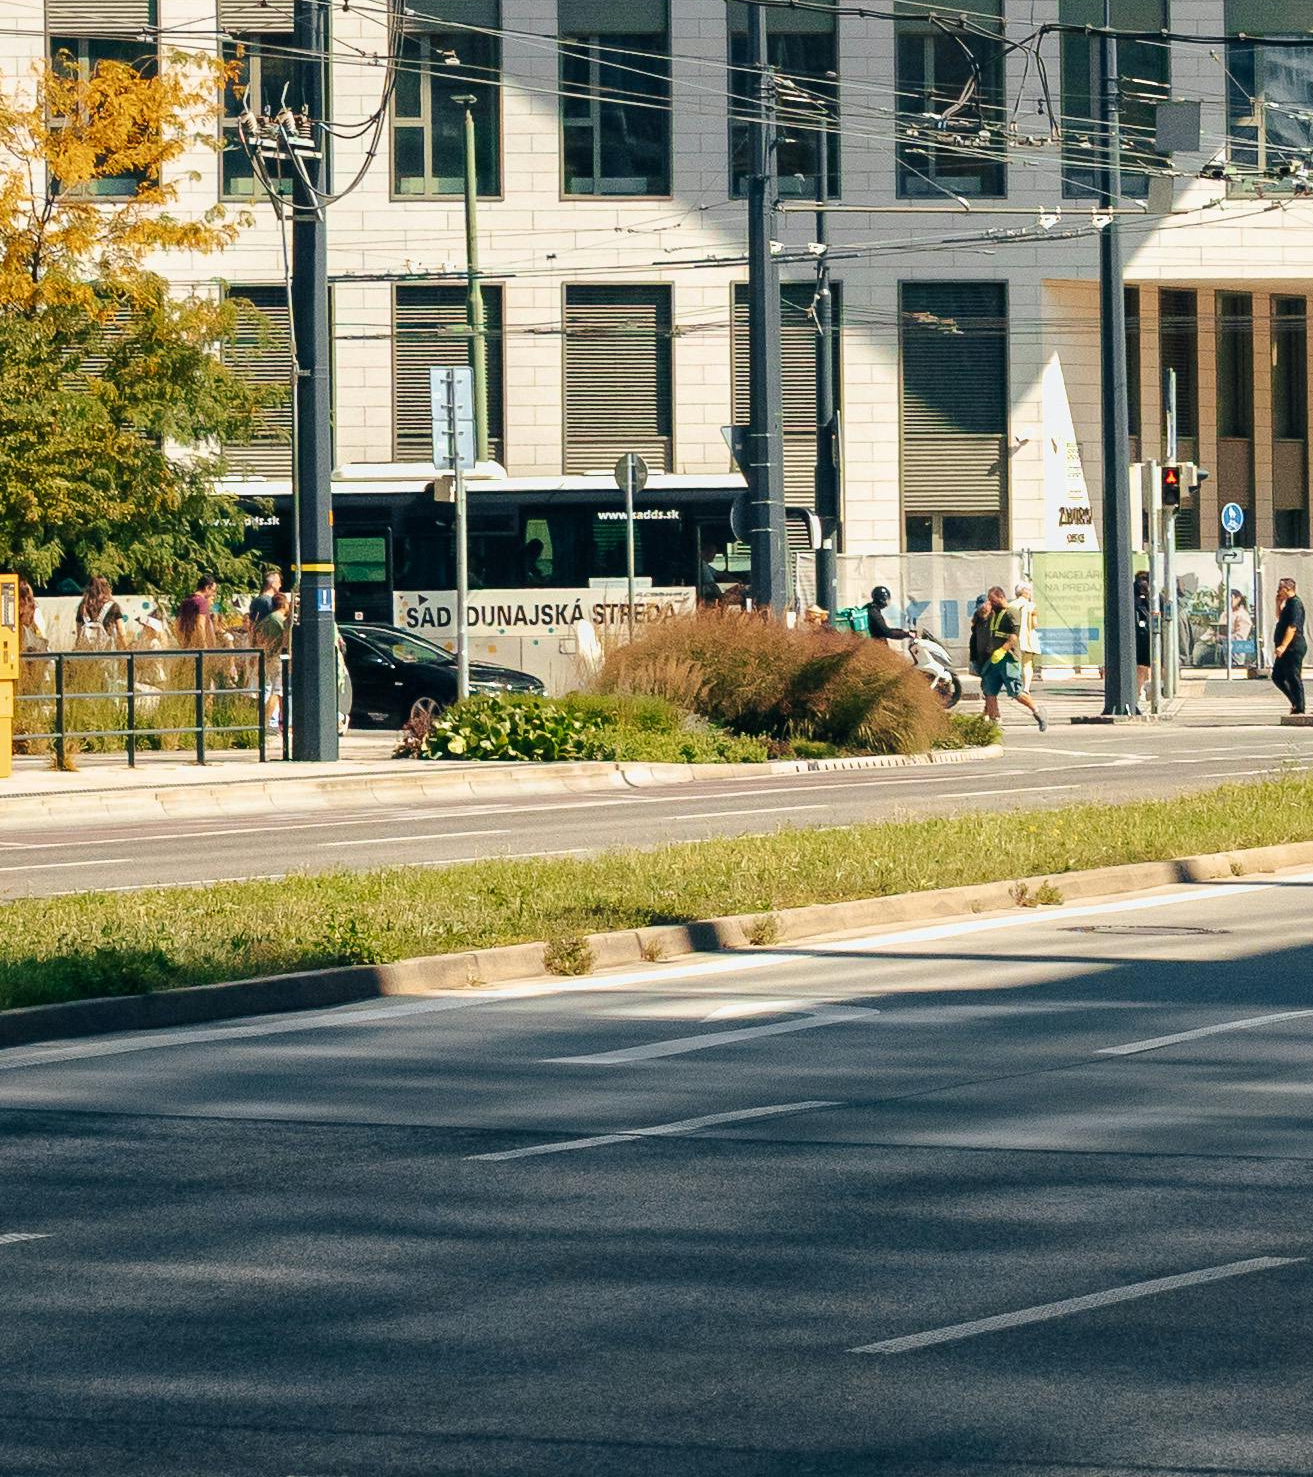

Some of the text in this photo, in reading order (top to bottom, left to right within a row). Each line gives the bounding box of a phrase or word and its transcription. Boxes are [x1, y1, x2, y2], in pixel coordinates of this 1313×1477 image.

[598, 510, 679, 521] wwwsadds.sk
[406, 606, 451, 628] SAD
[467, 598, 584, 626] DUNAJSKÁ
